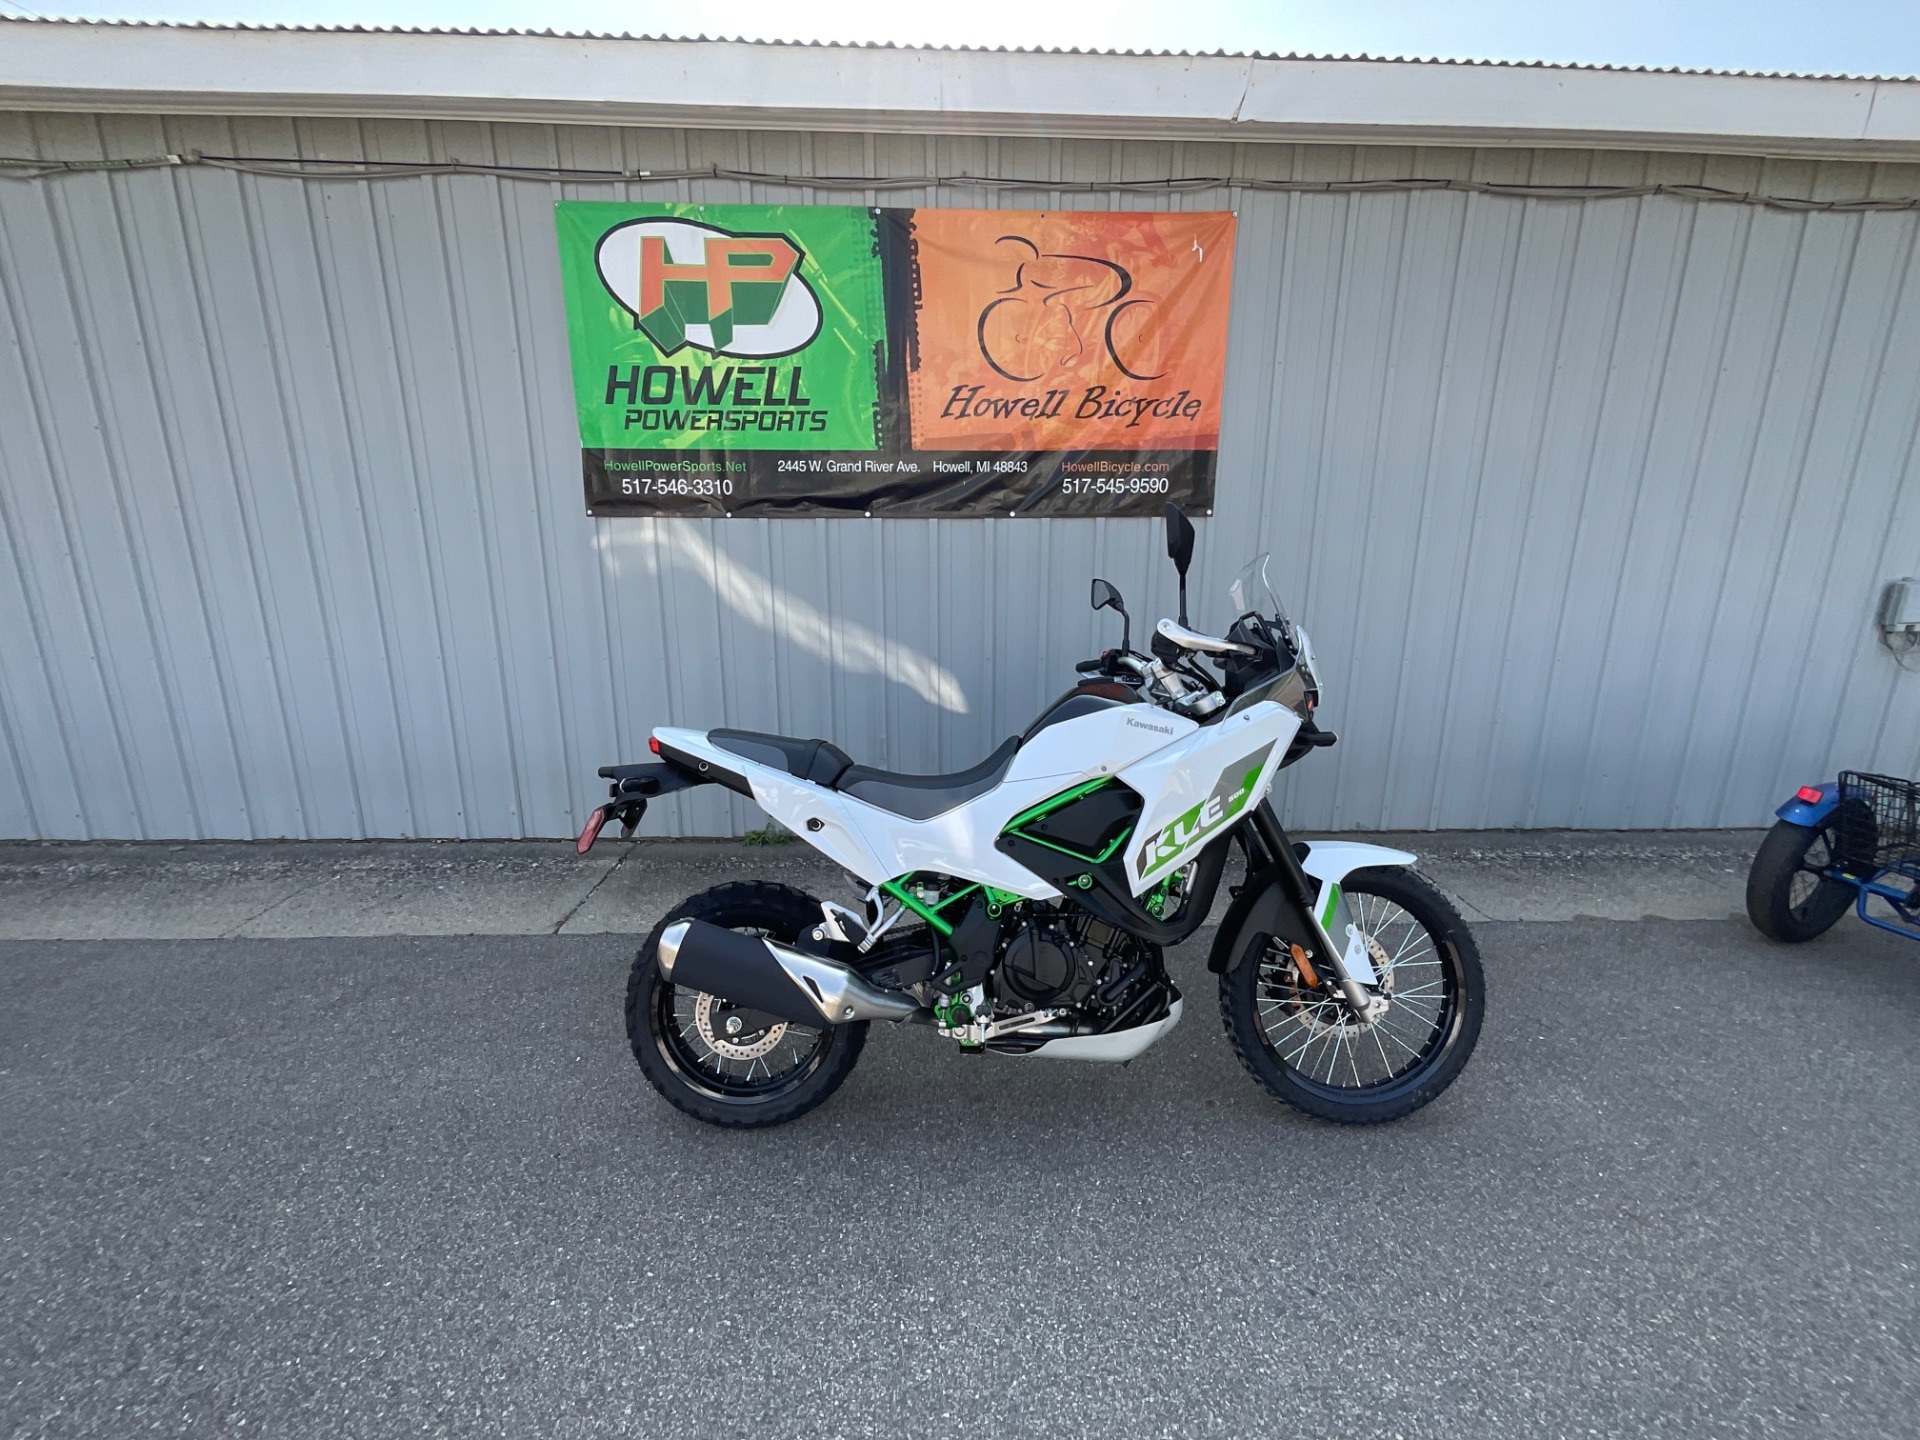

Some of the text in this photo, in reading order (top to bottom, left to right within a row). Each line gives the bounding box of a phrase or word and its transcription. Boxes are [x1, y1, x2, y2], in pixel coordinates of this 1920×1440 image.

[605, 365, 811, 406] HOWELL
[940, 384, 1202, 428] Howell Bicycle
[624, 409, 828, 432] POWERSPORTS
[604, 460, 747, 474] HowellPowerSports.Net
[777, 460, 921, 473] 2445 W. Grand River Ave.
[933, 461, 1028, 474] Howell, MI 48843
[1061, 461, 1170, 475] HowellBicycle.com
[622, 478, 733, 496] 517-546-3310
[1061, 477, 1169, 495] 517-545-9590
[1126, 717, 1173, 735] Kawasaki
[1228, 787, 1245, 803] 500
[1145, 795, 1224, 868] KLE
